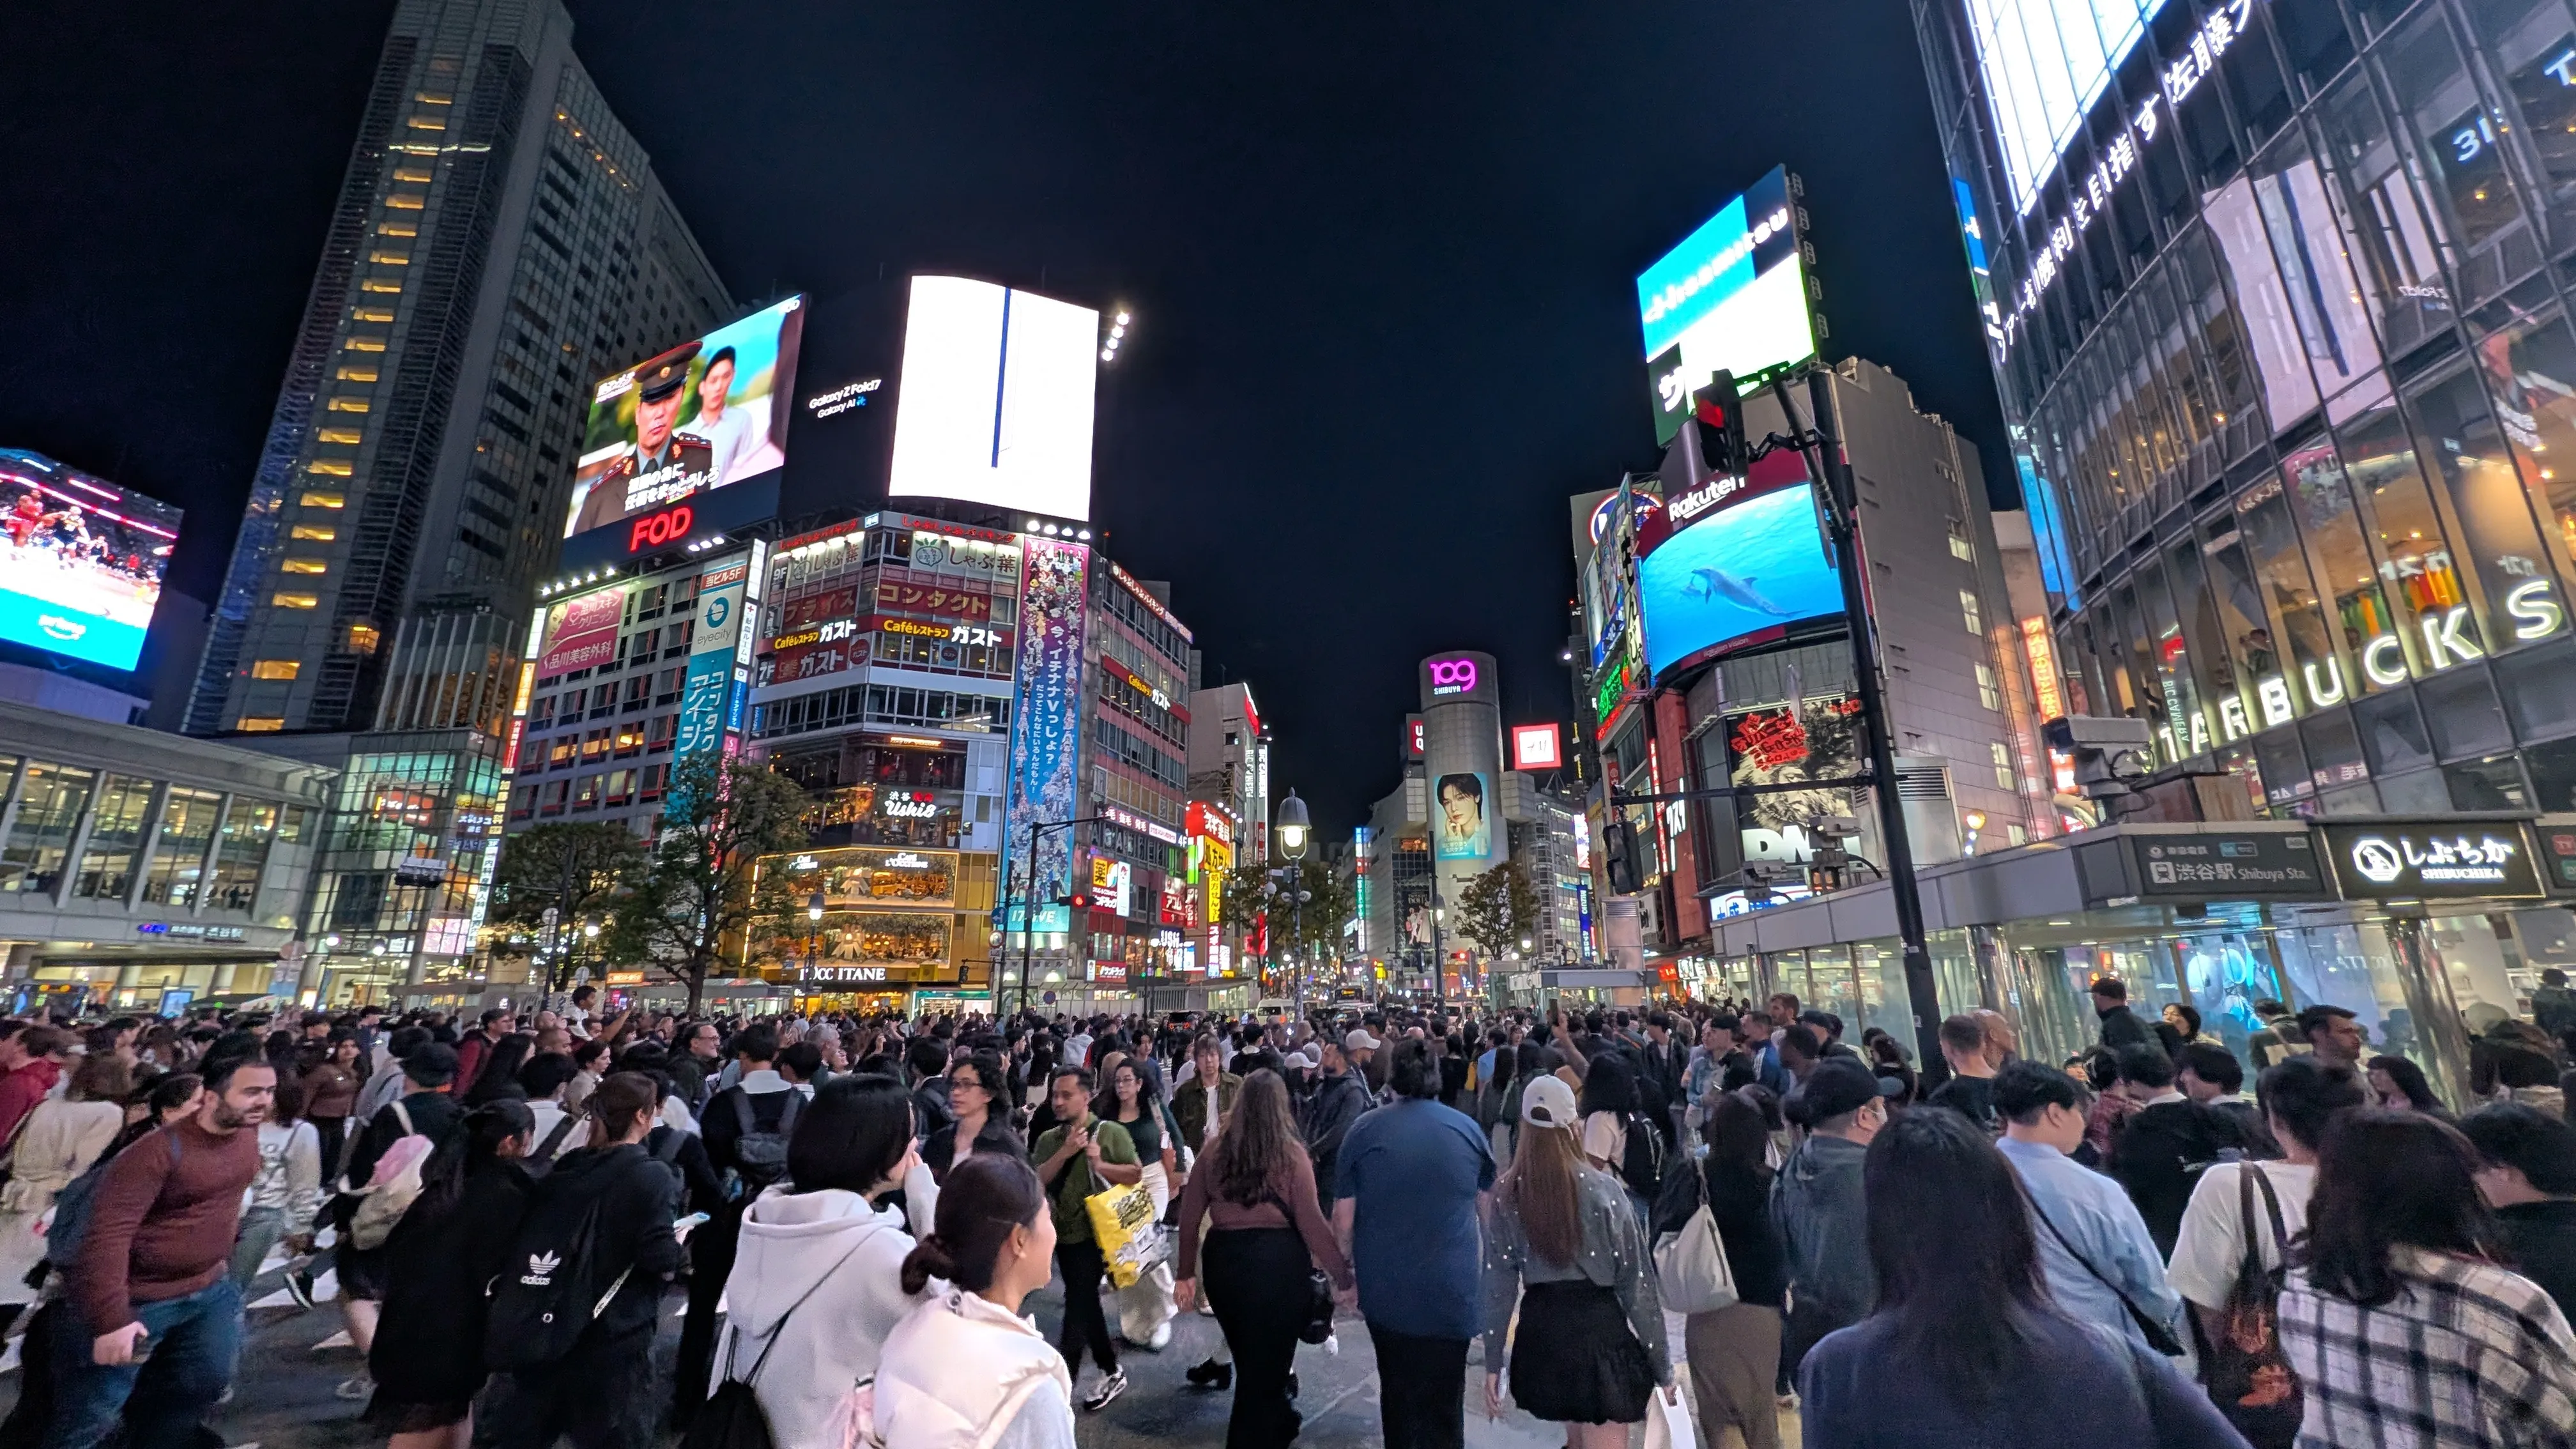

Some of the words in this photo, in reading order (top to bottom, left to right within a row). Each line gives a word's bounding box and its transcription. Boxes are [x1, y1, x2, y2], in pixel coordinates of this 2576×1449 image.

[809, 389, 843, 409] Galaxy
[843, 386, 851, 397] Z
[850, 379, 882, 395] Fold7
[817, 402, 847, 418] Galaxy
[846, 398, 856, 408] AI
[1668, 476, 1745, 522] Rakuten
[629, 507, 691, 552] FOD
[814, 543, 859, 571] しゃぶ葉
[949, 546, 1016, 573] しゃぶ葉
[705, 567, 742, 588] 当ビル5F
[773, 566, 788, 581] 9F
[579, 594, 621, 615] 品川スキン
[878, 583, 988, 615] コンタクト
[578, 610, 614, 629] クリニック
[697, 628, 732, 647] eyecity
[774, 631, 819, 650] Caféレストラン
[819, 618, 857, 643] ガスト
[884, 619, 949, 639] Caféレストラン
[951, 625, 1002, 647] ガスト
[1727, 638, 1749, 648] Vision
[548, 640, 613, 670] 品川美容外科
[798, 648, 845, 678] ガスト
[852, 649, 868, 659] ガスト
[759, 661, 776, 682] 7F
[1429, 660, 1476, 692] 109
[1152, 687, 1171, 711] ガスト
[1433, 685, 1462, 696] SHIBUYA
[889, 790, 911, 802] 渋谷
[884, 799, 937, 818] Ushi8
[1177, 834, 1188, 848] 4F
[2400, 838, 2515, 866] しぶちか
[1095, 861, 1106, 884] 薬
[2175, 862, 2237, 881] 渋谷駅
[2237, 868, 2285, 882] Shibuya
[2420, 868, 2504, 880] SHIBUCHIKA
[1094, 894, 1117, 908] ンドラッグ
[1166, 894, 1183, 910] アコム
[519, 1275, 551, 1286] adidas
